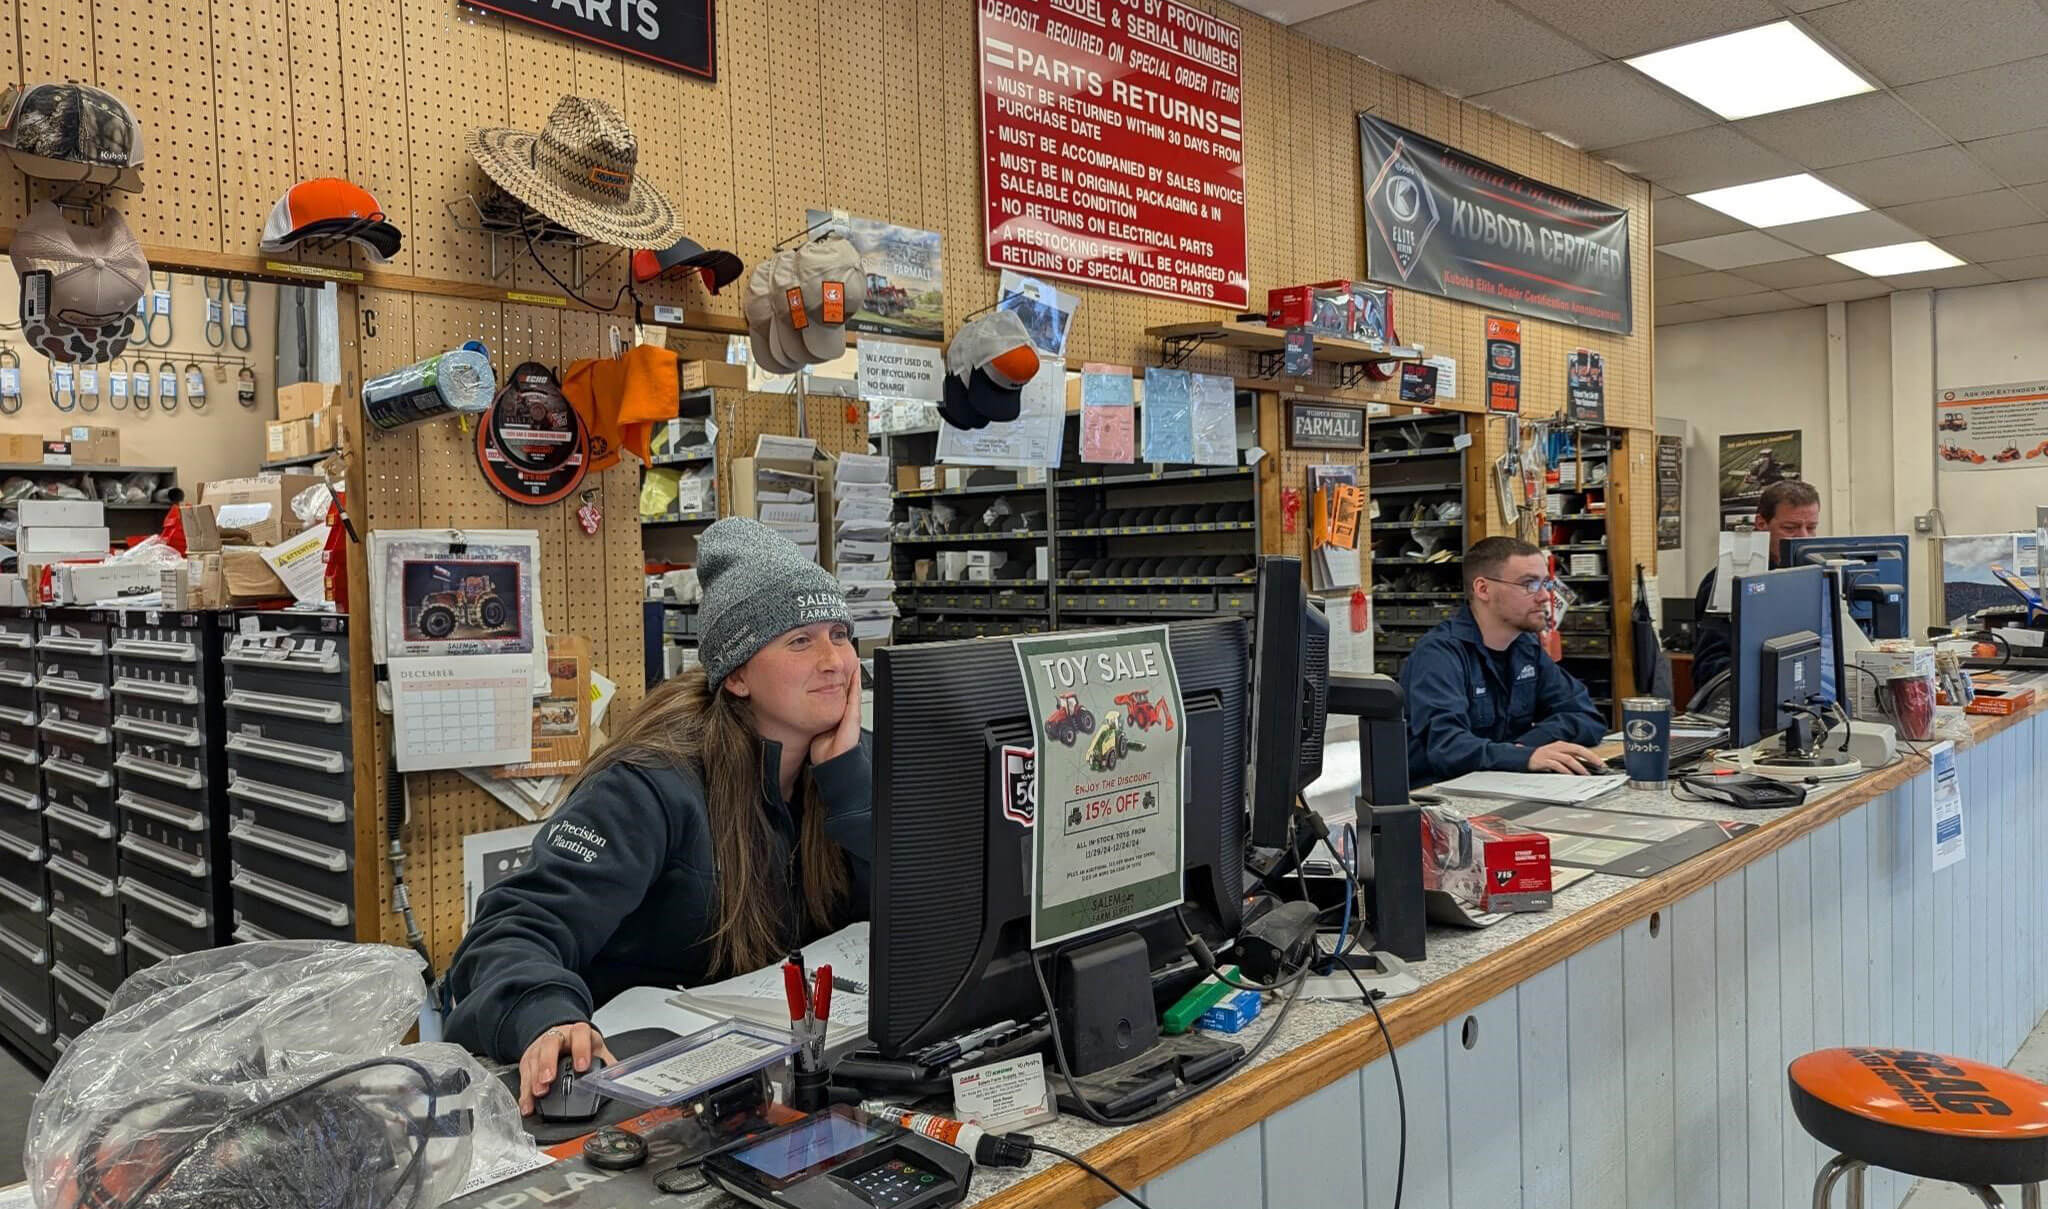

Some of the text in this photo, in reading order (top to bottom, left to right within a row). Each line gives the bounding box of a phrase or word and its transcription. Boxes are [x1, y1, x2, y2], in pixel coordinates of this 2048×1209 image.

[1111, 8, 1121, 28] &
[1128, 14, 1178, 50] SERIAL
[1183, 36, 1238, 73] NUMBER
[1145, 0, 1239, 49] BY PROVIDING
[985, 2, 1240, 105] DEPOSIT REQUIRED ON SPECIAL ORDER ITEMS
[1017, 48, 1219, 134] PARTS RETURNS
[997, 75, 1241, 163] MUST BE RETURNED WITHIN 30 DAYS FROM
[997, 97, 1101, 141] PURCHASE DATE
[999, 125, 1244, 205] MUST BE ACCOMPANIED BY SALES INVOICE
[999, 154, 1221, 221] MUST BE IN ORIGINAL PACKAGING & IN
[1000, 173, 1137, 220] SALEABLE CONDITION
[1001, 197, 1214, 257] NO RETURNS ON ELECTRICAL PARTS
[1393, 225, 1416, 247] ELITE
[1451, 197, 1622, 280] KUBOTA CERTIFIED
[893, 263, 931, 280] FARMALL
[1003, 225, 1242, 284] A RESTOCKING FEE WILL BE CHARGED ON
[1002, 246, 1214, 298] RETURNS OF SPECIAL ORDER PARTS
[1443, 270, 1475, 290] Kubota
[1477, 276, 1496, 293] Elite
[879, 355, 902, 365] ACCEPT
[904, 358, 921, 367] USED
[922, 360, 934, 368] OIL
[881, 369, 916, 379] RECYCLING
[918, 372, 930, 380] FOR
[526, 375, 548, 384] ECHO
[1295, 416, 1360, 437] FARMALL
[797, 593, 838, 608] SALEM
[800, 608, 830, 620] FARM
[401, 667, 454, 679] DECEMBER
[1040, 649, 1160, 689] TOY SALE
[1075, 772, 1152, 795] ENJOY THE DISCOUNT
[1085, 792, 1140, 820] 15% OFF
[560, 820, 607, 848] Precision
[1076, 826, 1146, 850] ALL IN-STOCK TOYS FROM
[1497, 871, 1512, 879] 715
[1092, 895, 1120, 911] SALEM
[1871, 1068, 1942, 1115] EQUIPMENT
[1873, 1049, 2014, 1117] SCAG
